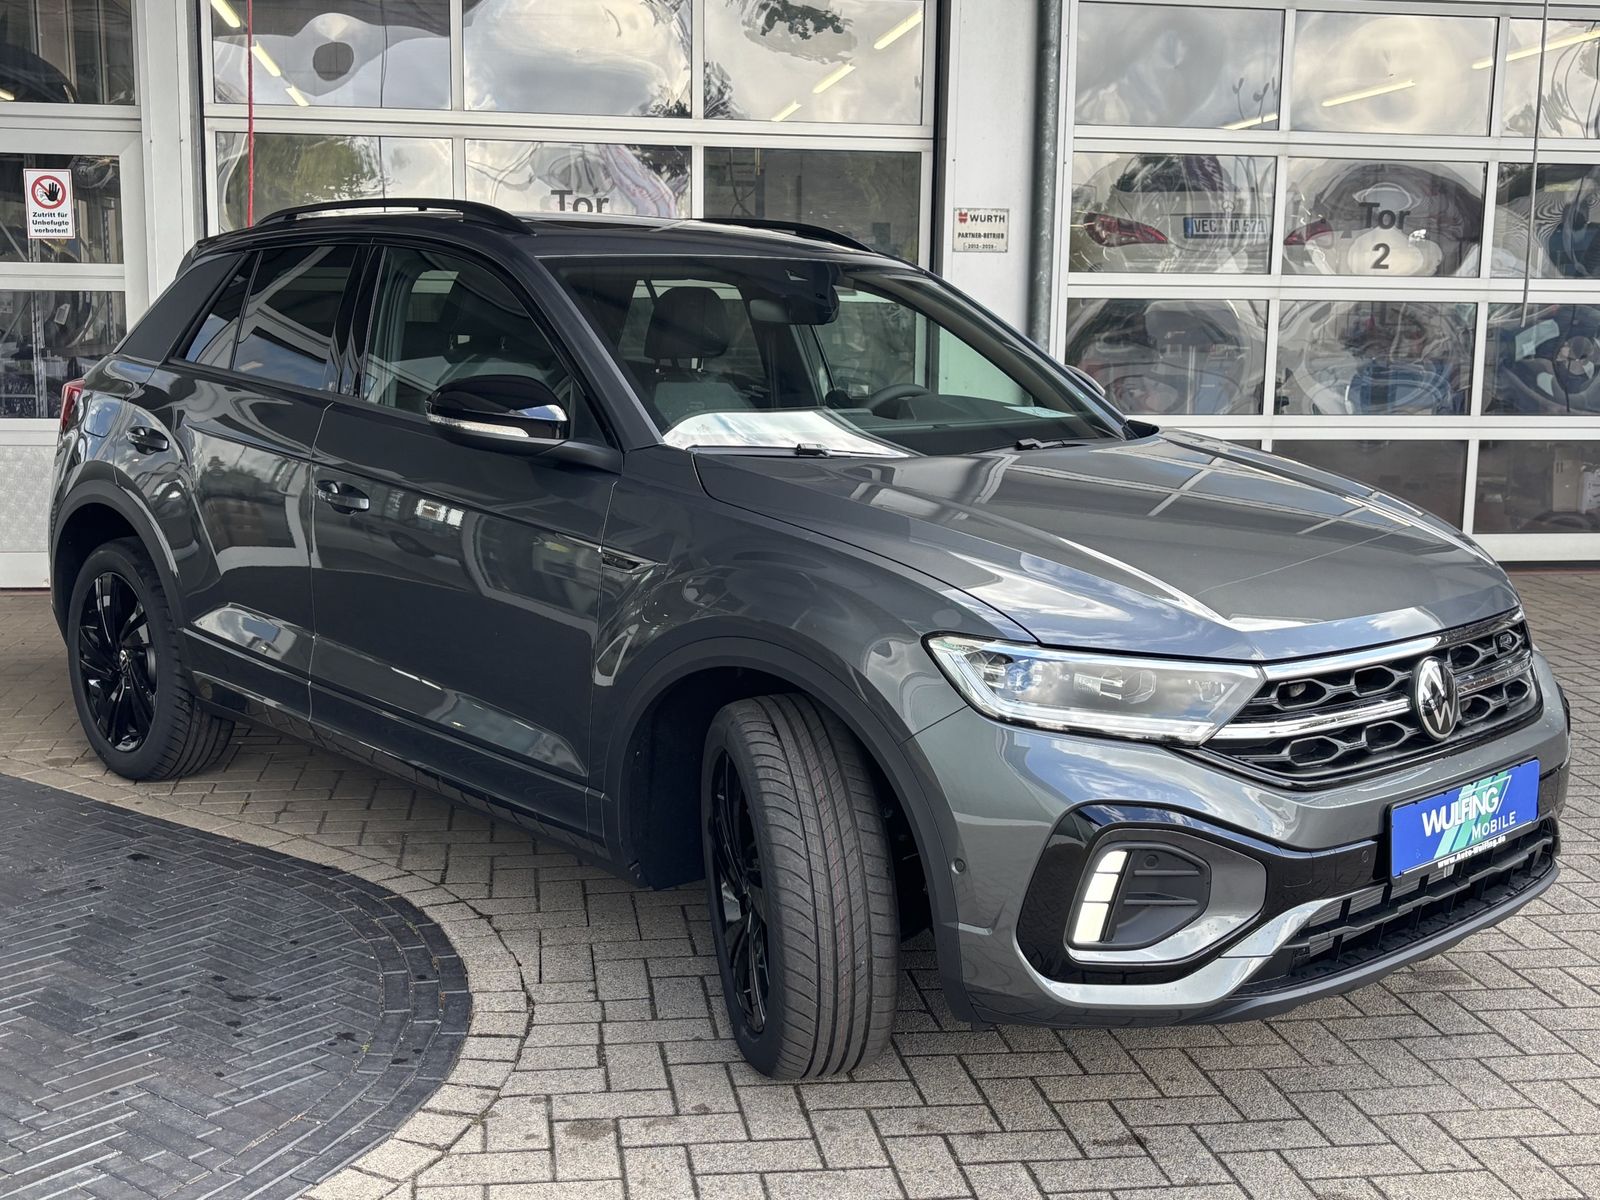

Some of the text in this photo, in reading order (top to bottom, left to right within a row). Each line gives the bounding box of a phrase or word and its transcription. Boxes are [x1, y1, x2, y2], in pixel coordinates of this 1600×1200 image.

[551, 190, 609, 213] Tor
[1193, 219, 1217, 233] VEC
[1359, 202, 1411, 230] Tor
[957, 231, 1004, 239] PARTNER-BETRIEB
[1371, 242, 1390, 269] 2
